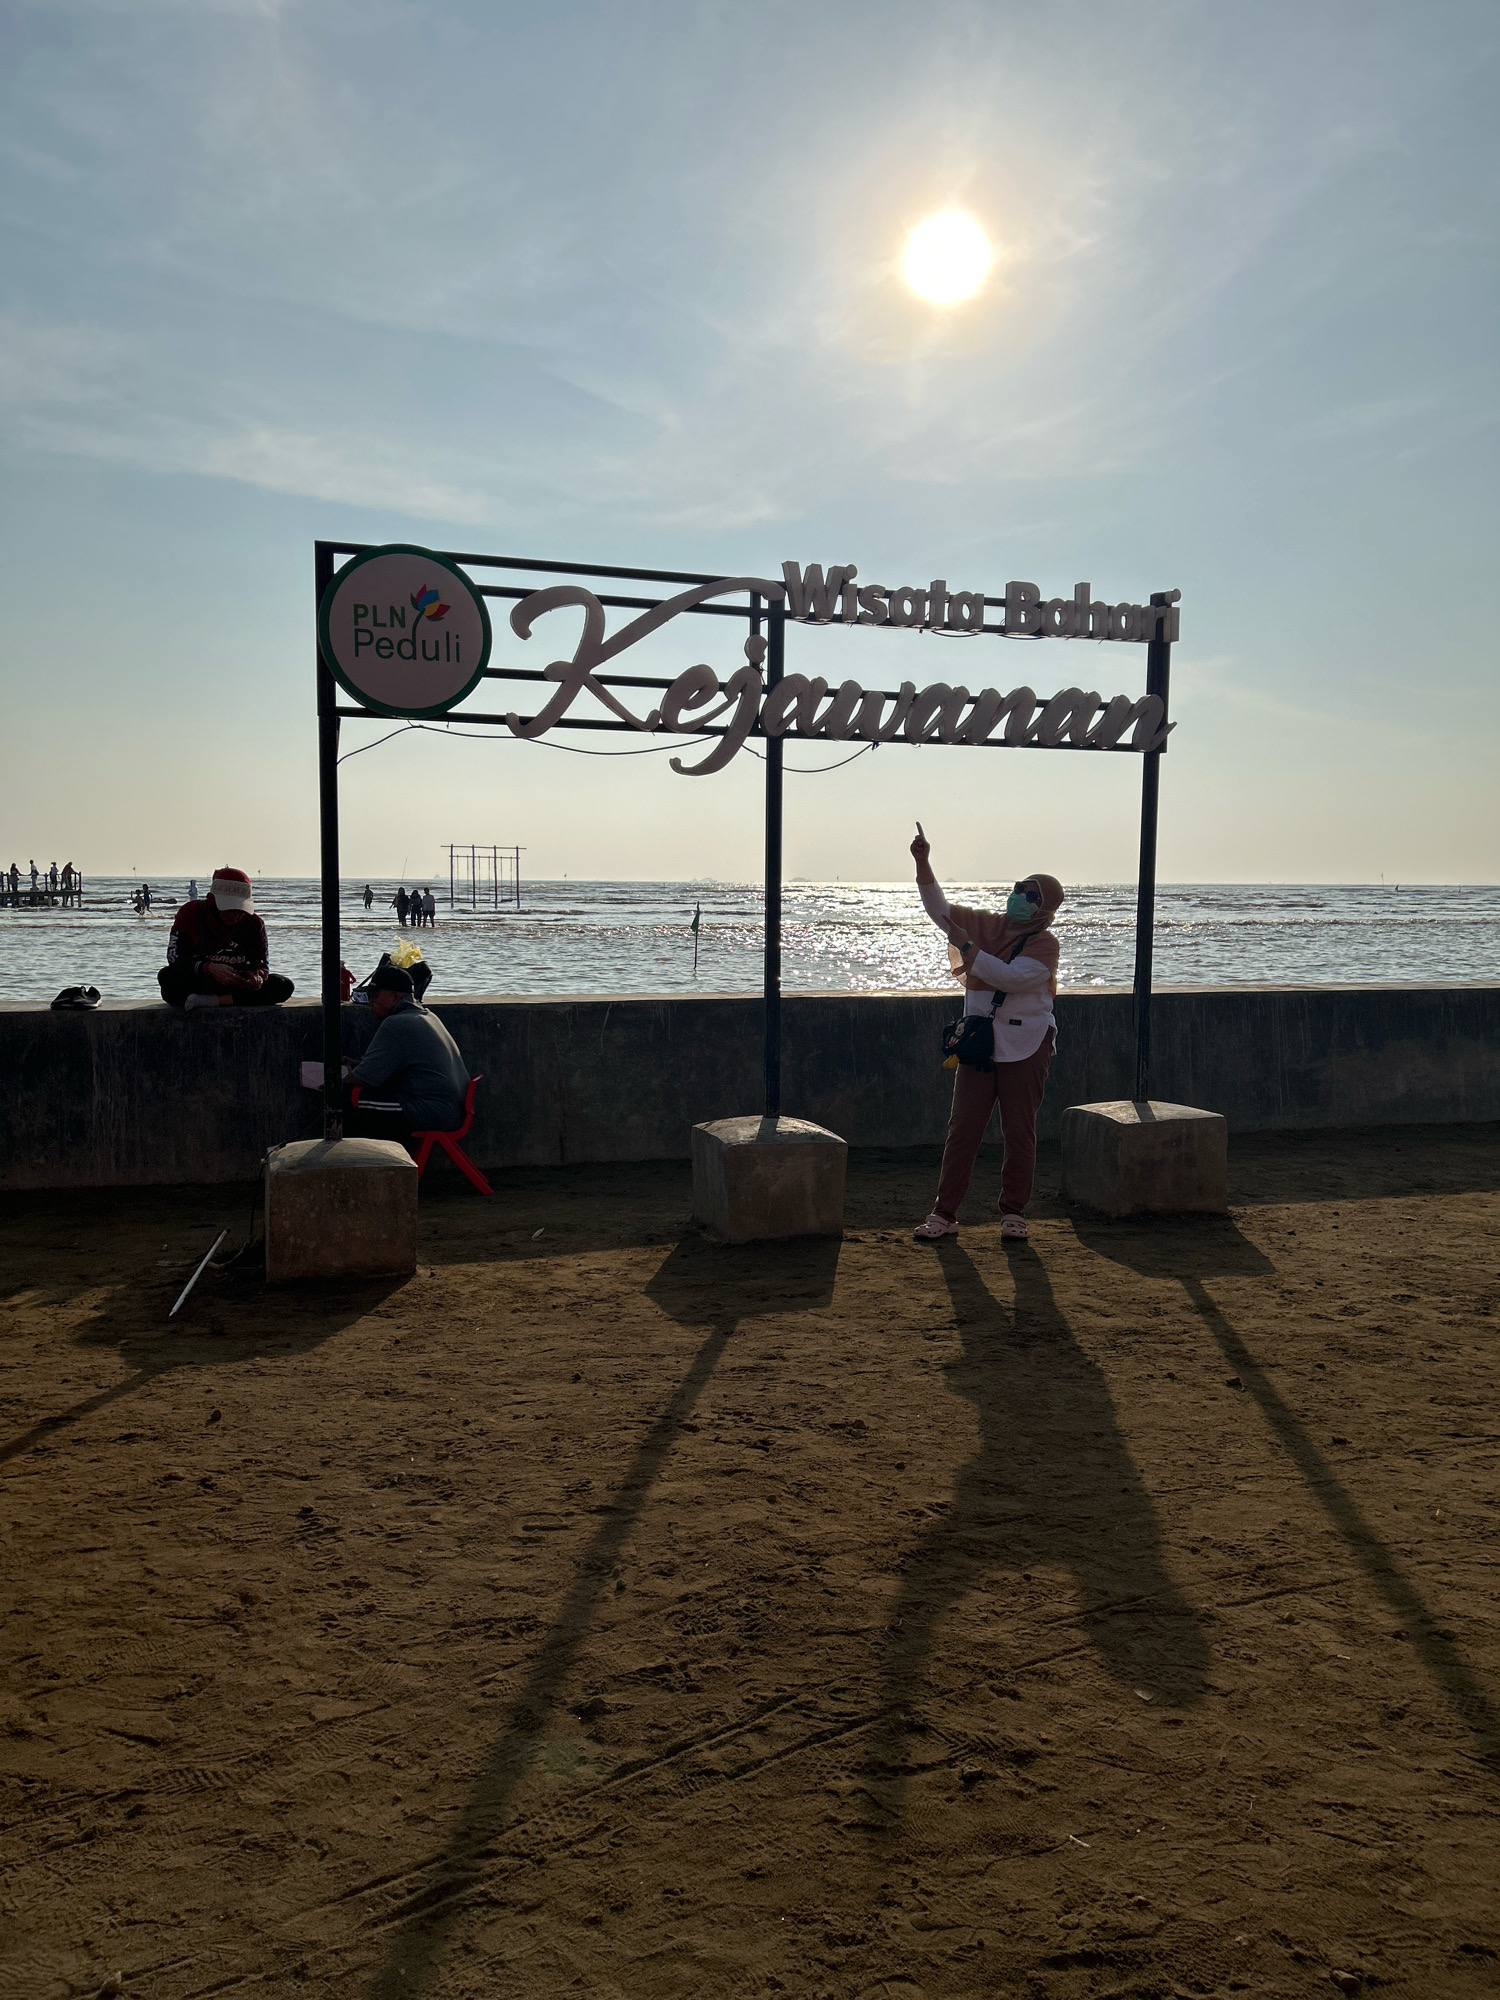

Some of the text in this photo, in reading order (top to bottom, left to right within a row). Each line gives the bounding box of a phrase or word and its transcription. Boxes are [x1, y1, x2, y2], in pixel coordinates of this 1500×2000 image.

[353, 603, 406, 628] PLN
[782, 560, 1181, 643] Wisata Bahari
[354, 628, 460, 662] Peduli
[505, 577, 1177, 776] Kejawanan
